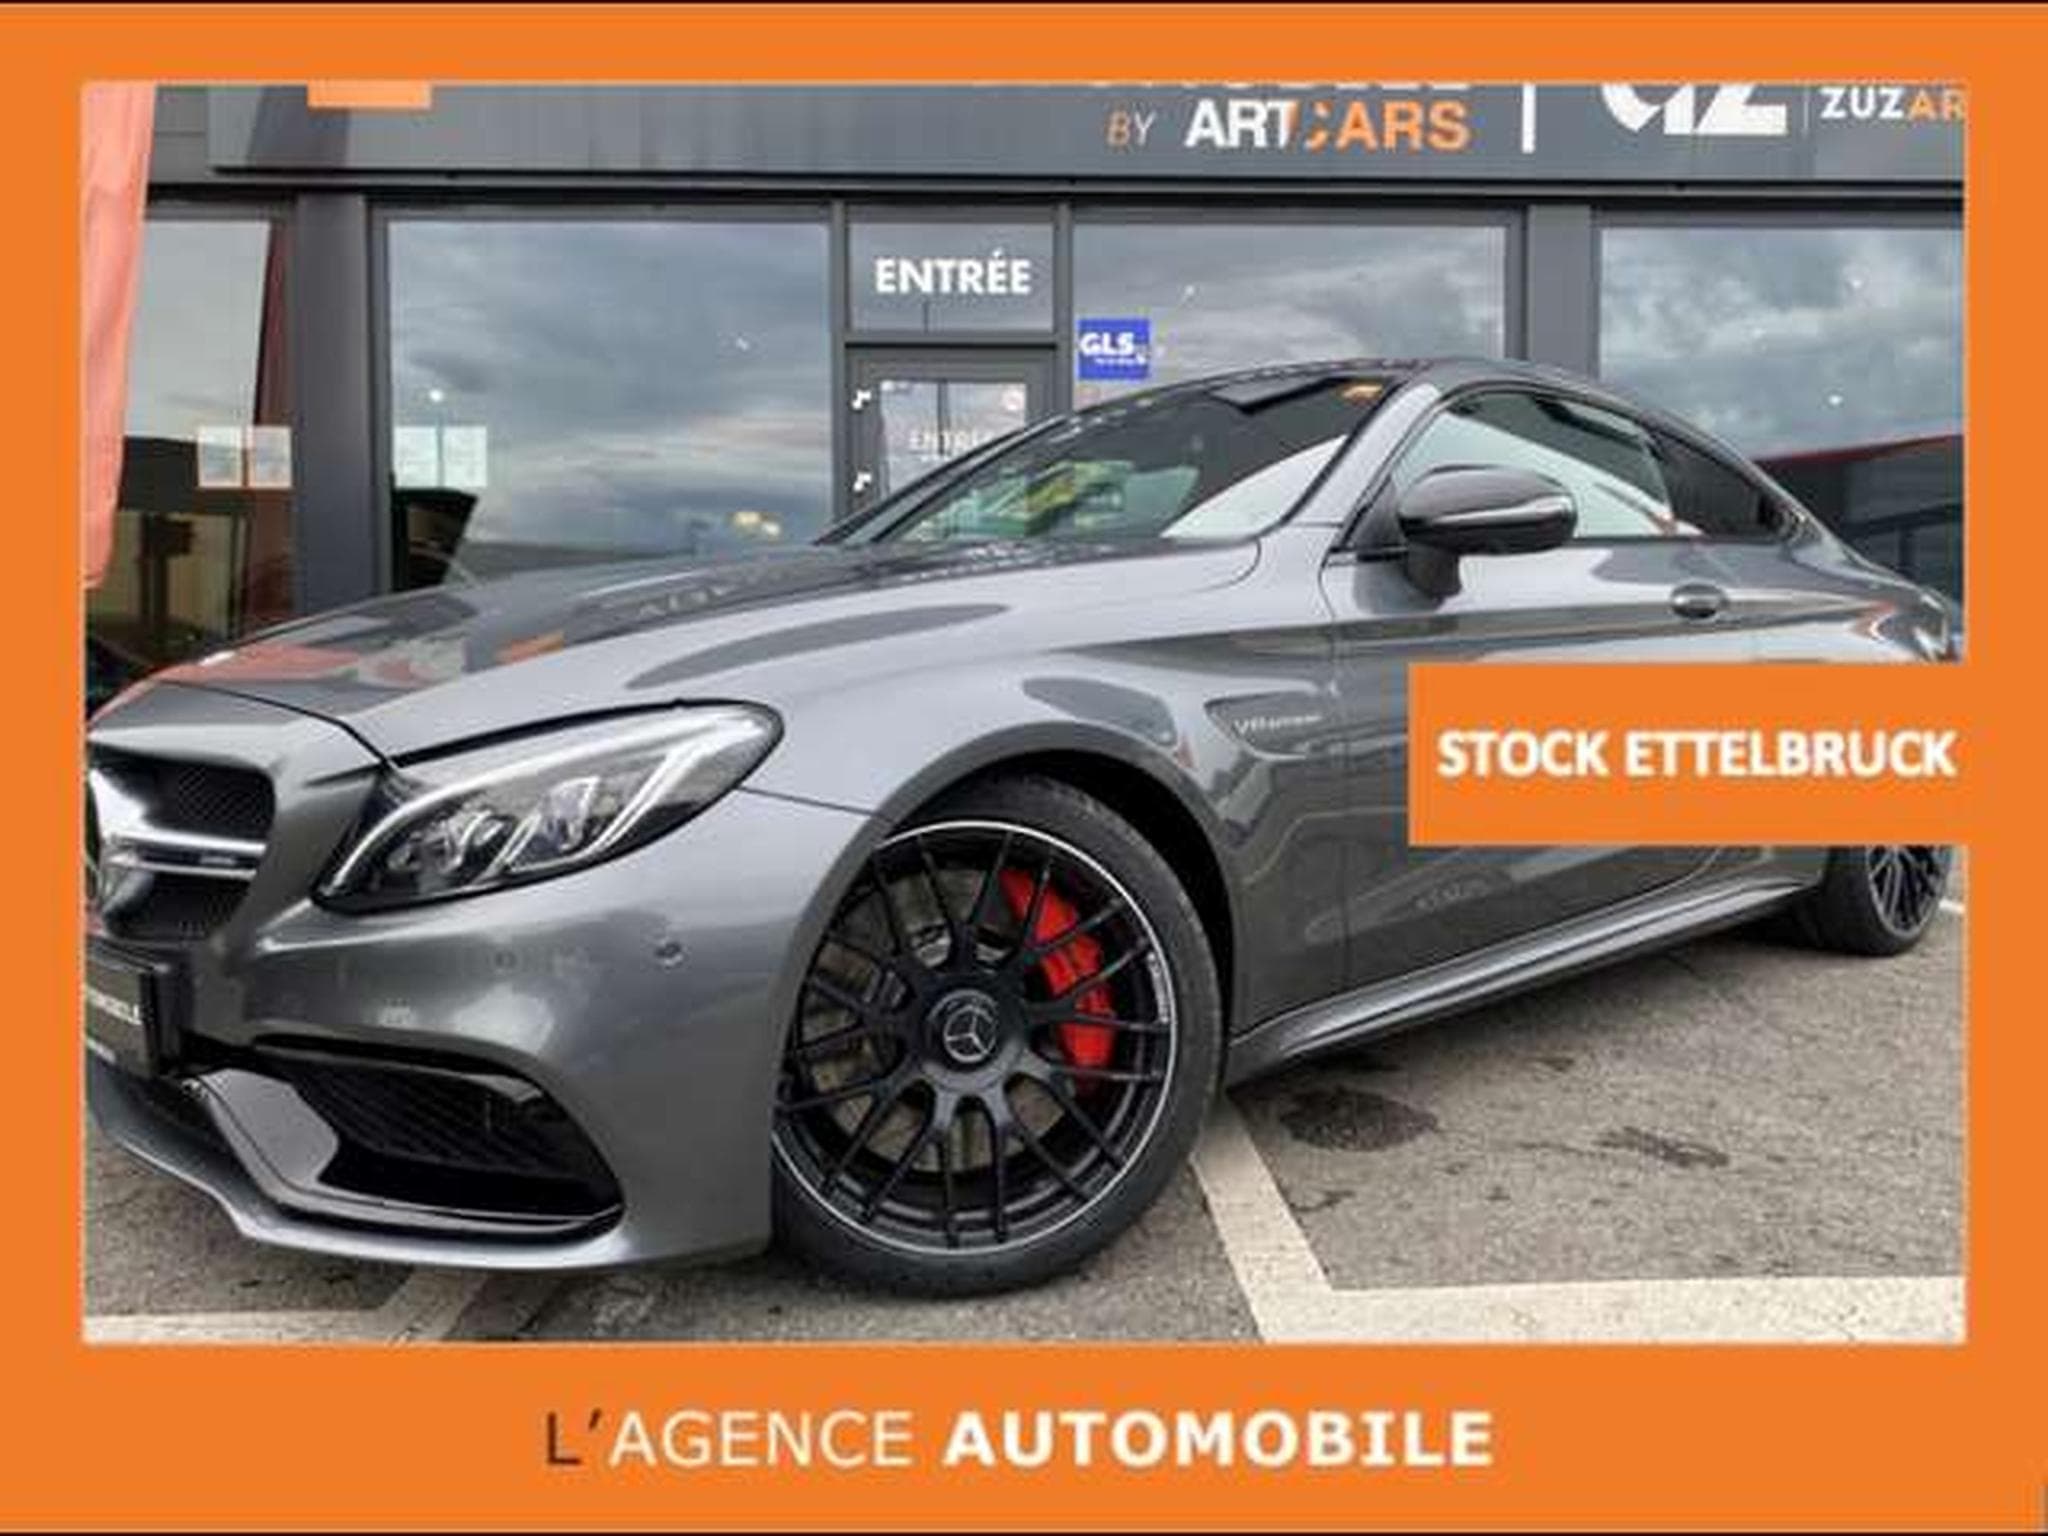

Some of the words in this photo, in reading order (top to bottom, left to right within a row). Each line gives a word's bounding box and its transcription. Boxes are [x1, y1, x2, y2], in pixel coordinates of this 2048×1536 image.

[1107, 111, 1156, 147] BY
[874, 248, 1032, 295] ENTRÉE
[1079, 331, 1135, 357] GLS
